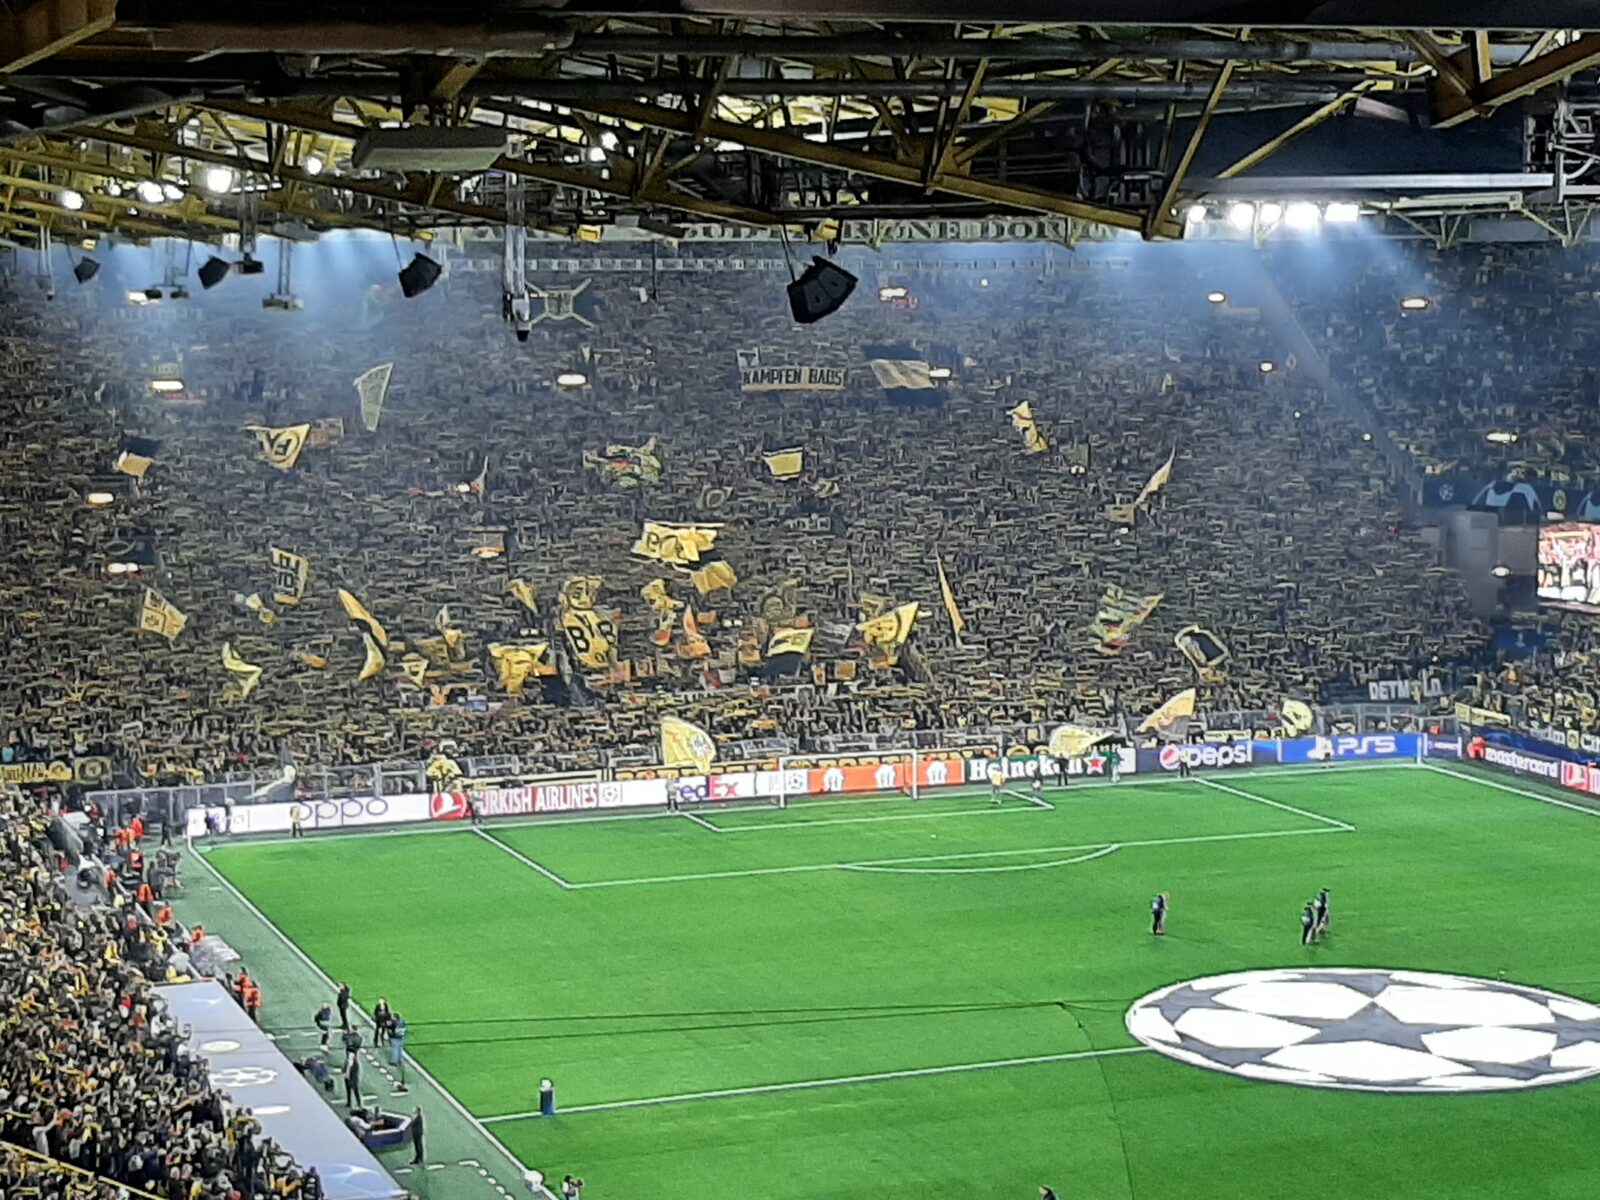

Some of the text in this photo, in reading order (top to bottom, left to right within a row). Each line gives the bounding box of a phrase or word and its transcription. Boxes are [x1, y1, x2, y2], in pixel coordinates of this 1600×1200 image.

[1186, 742, 1252, 769] pepsi
[1338, 735, 1398, 755] PS5
[969, 755, 1083, 781] Heinekn
[1485, 747, 1558, 778] mastercard
[471, 783, 598, 816] URKISH AIRLINES
[674, 775, 738, 803] edEx
